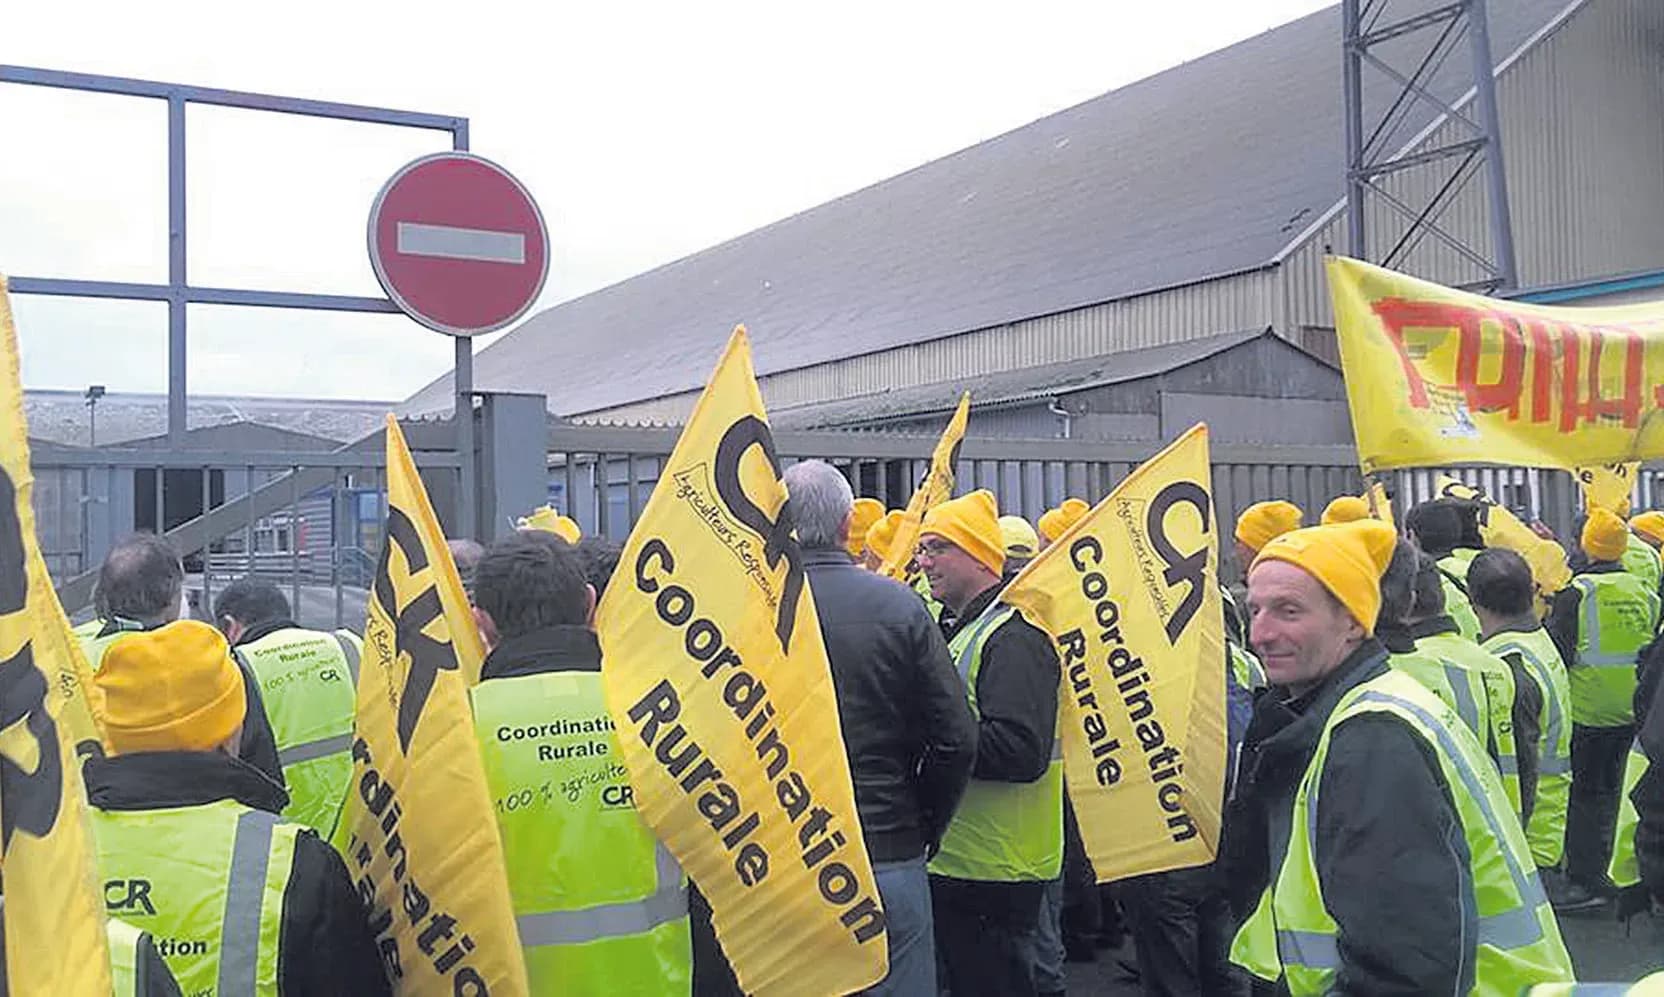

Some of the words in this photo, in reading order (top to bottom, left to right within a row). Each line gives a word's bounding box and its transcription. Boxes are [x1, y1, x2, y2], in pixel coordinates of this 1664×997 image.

[320, 669, 341, 681] CR
[1070, 535, 1199, 843] Coordination
[497, 716, 617, 742] Coordinati
[1057, 628, 1122, 787] Rurale
[538, 741, 608, 761] Rurale
[635, 538, 887, 945] Coordination
[497, 789, 533, 813] 100
[560, 763, 628, 802] agriculte
[602, 785, 637, 809] CR
[627, 679, 770, 888] Rurale
[352, 737, 489, 997] rdinatio
[104, 880, 157, 915] CR
